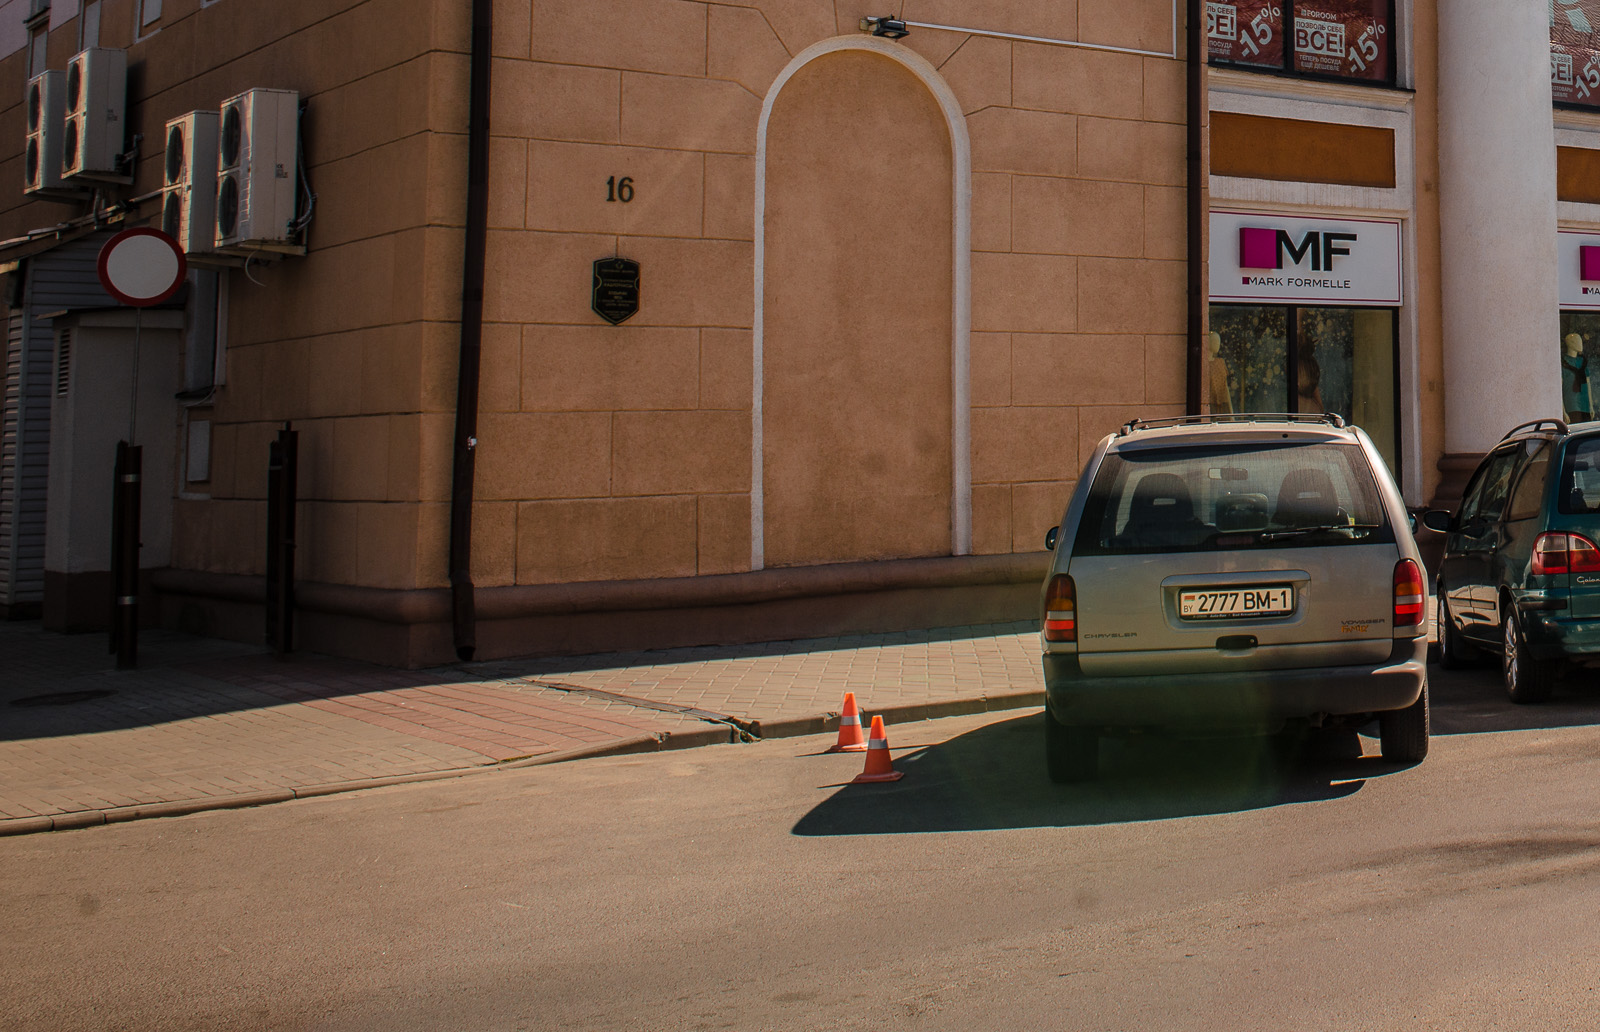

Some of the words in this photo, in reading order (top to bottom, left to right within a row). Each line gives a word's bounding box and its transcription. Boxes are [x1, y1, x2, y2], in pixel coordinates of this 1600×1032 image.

[1240, 2, 1281, 57] -15%
[1296, 29, 1343, 54] ВСЕ!
[1348, 20, 1386, 73] -15%
[606, 175, 635, 203] 16
[1276, 229, 1358, 272] MF
[1247, 277, 1283, 287] MARK
[1287, 278, 1352, 289] FORMELLE
[1184, 605, 1193, 613] BY
[1198, 592, 1240, 613] 2777
[1243, 590, 1287, 611] BM-1
[1341, 618, 1385, 626] VOYAGER
